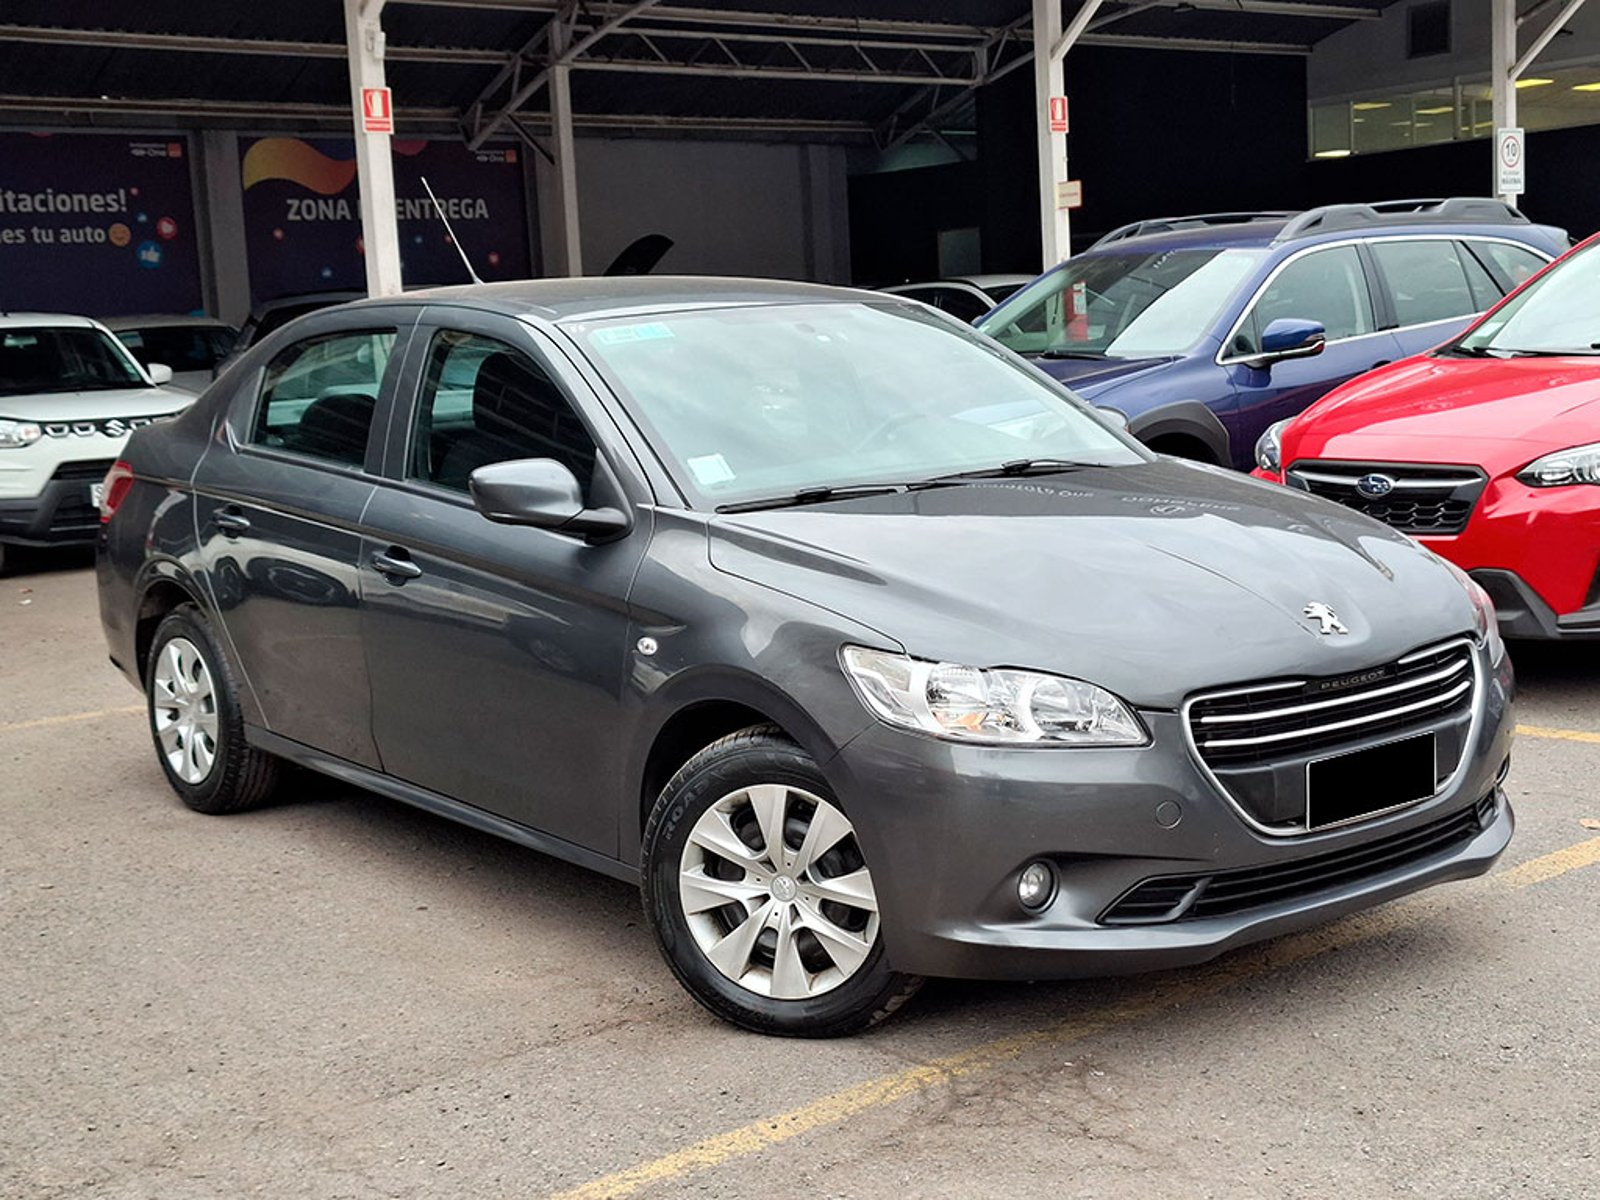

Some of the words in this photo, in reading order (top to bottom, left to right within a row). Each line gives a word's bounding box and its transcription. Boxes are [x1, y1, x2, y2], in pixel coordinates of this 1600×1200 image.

[1506, 143, 1517, 157] 10
[286, 199, 350, 221] ZONA
[397, 198, 489, 220] ENTREGA
[31, 226, 54, 244] tu
[59, 226, 106, 244] auto
[1321, 669, 1385, 690] PEUGEOT
